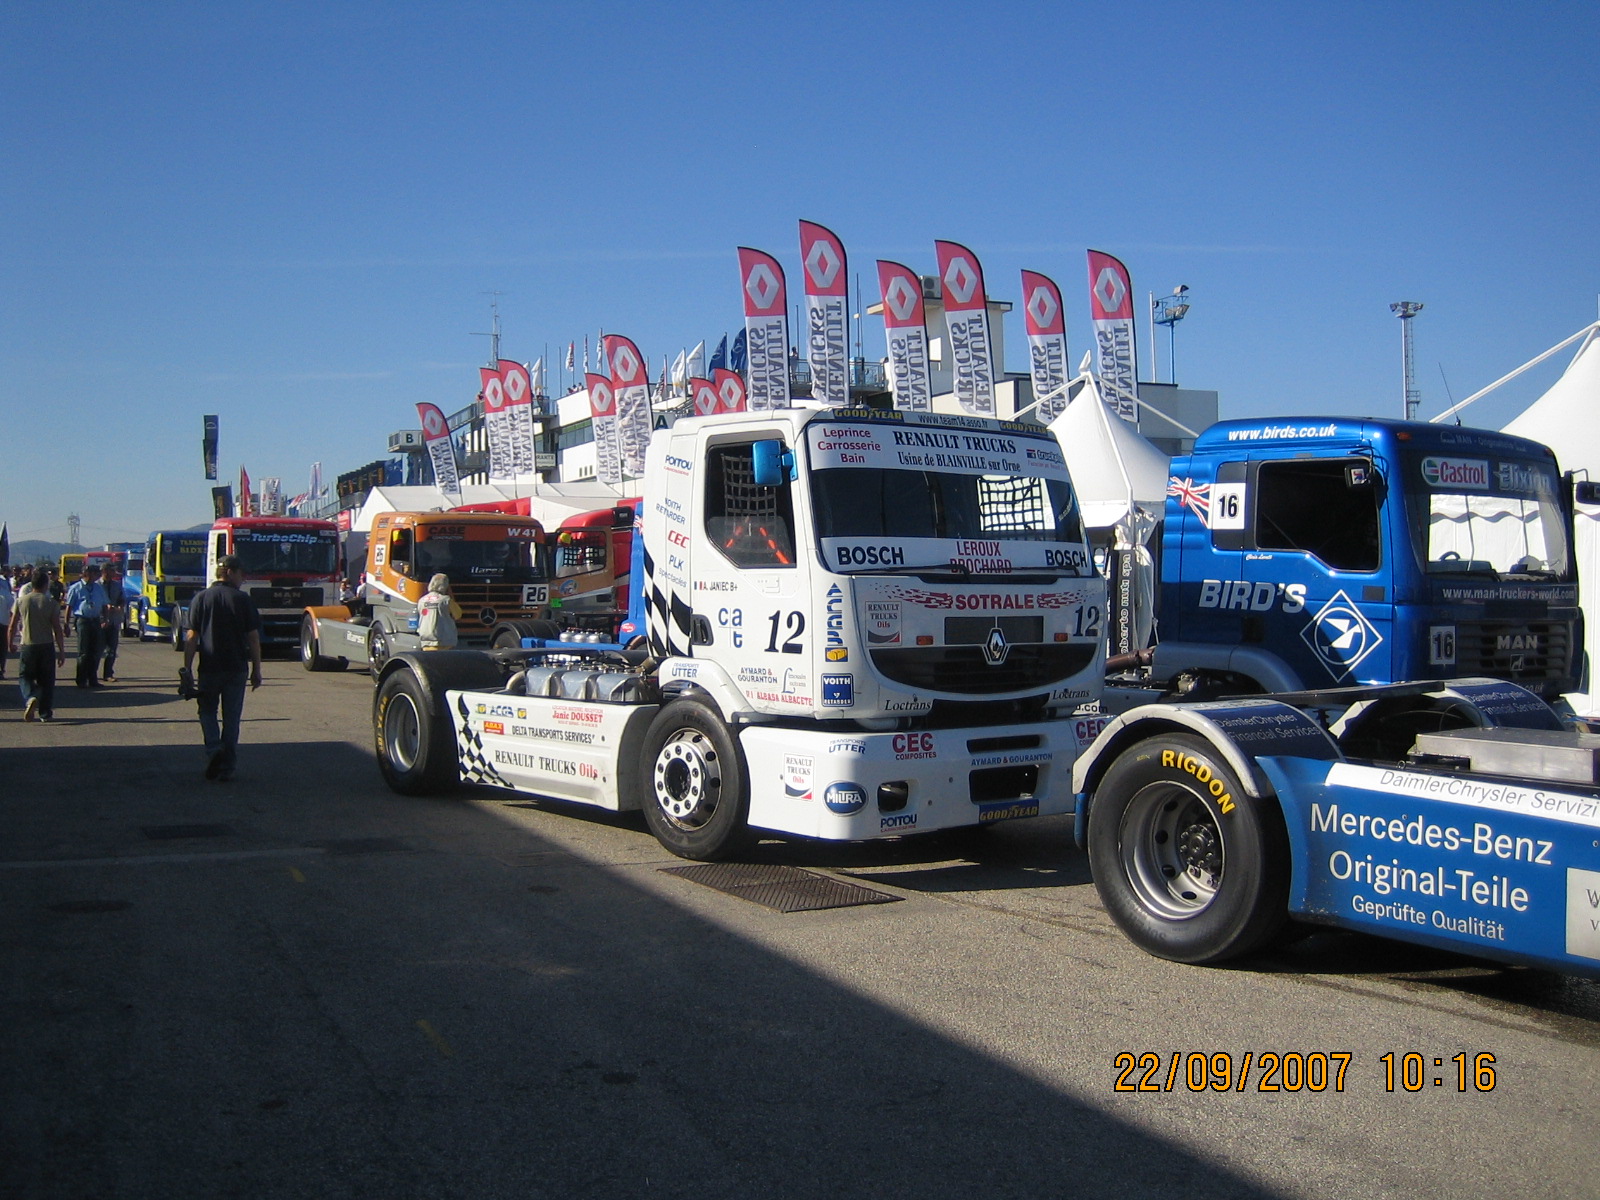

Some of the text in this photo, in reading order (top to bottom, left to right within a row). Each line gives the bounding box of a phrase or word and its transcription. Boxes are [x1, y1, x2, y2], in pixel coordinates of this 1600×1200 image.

[655, 415, 669, 429] A
[406, 434, 414, 443] B
[823, 428, 871, 439] Leprince
[1228, 423, 1337, 441] www.birds.co.uk
[818, 441, 881, 452] Carrosserie
[893, 431, 1016, 454] RENAULT TRUCKS
[665, 455, 692, 470] POITOU
[840, 453, 865, 464] Bain
[898, 452, 921, 465] Usine
[925, 453, 934, 466] de
[935, 454, 987, 470] BLAINVILLE
[988, 460, 1000, 471] sur
[1002, 458, 1021, 472] Orne
[1440, 461, 1486, 485] Castrol
[1218, 494, 1238, 517] 16
[428, 526, 466, 535] CASE
[507, 528, 536, 537] W 41
[668, 530, 690, 548] CEC
[837, 546, 904, 565] BOSCH
[956, 541, 1002, 557] LEROUX
[669, 554, 684, 571] PLK
[1045, 549, 1088, 568] BOSCH
[950, 559, 1012, 574] BROCHARD
[527, 587, 547, 602] 26
[1199, 579, 1307, 614] BIRD'S
[1443, 587, 1575, 600] www.man-truckers-world.com
[955, 594, 1035, 610] SOTRALE
[1072, 606, 1100, 637] 12
[764, 610, 805, 654] 12
[1119, 608, 1130, 655] oberto
[1433, 631, 1454, 660] 16
[1497, 635, 1538, 650] MAN
[672, 668, 697, 678] UTTER
[741, 667, 773, 676] AYMARD &
[738, 675, 777, 684] GOURANTON
[824, 677, 850, 685] VOITH
[1052, 688, 1090, 700] Loctrans
[884, 699, 932, 711] Loctrans
[570, 712, 603, 723] DOUSSET
[512, 725, 528, 735] DELTA
[528, 727, 564, 740] TRANSPORTS
[1227, 725, 1321, 742] Financial Services
[829, 743, 866, 755] UTTER
[892, 733, 933, 753] CEC
[786, 757, 812, 766] RENAULT
[895, 751, 937, 760] COMPOSITES
[971, 758, 1002, 766] AYMARD
[1009, 753, 1053, 764] GOURANTON
[495, 750, 598, 780] RENAULT TRUCKS Oils
[787, 766, 811, 775] TRUCKS
[1162, 749, 1236, 815] RIGDON
[1380, 770, 1600, 819] DaimlerChrysler Servizi
[881, 814, 917, 828] POITOU
[1310, 803, 1553, 865] Mercedes-Benz
[1329, 850, 1529, 912] Original-Teile
[1352, 895, 1505, 940] Geprüfte Qualität
